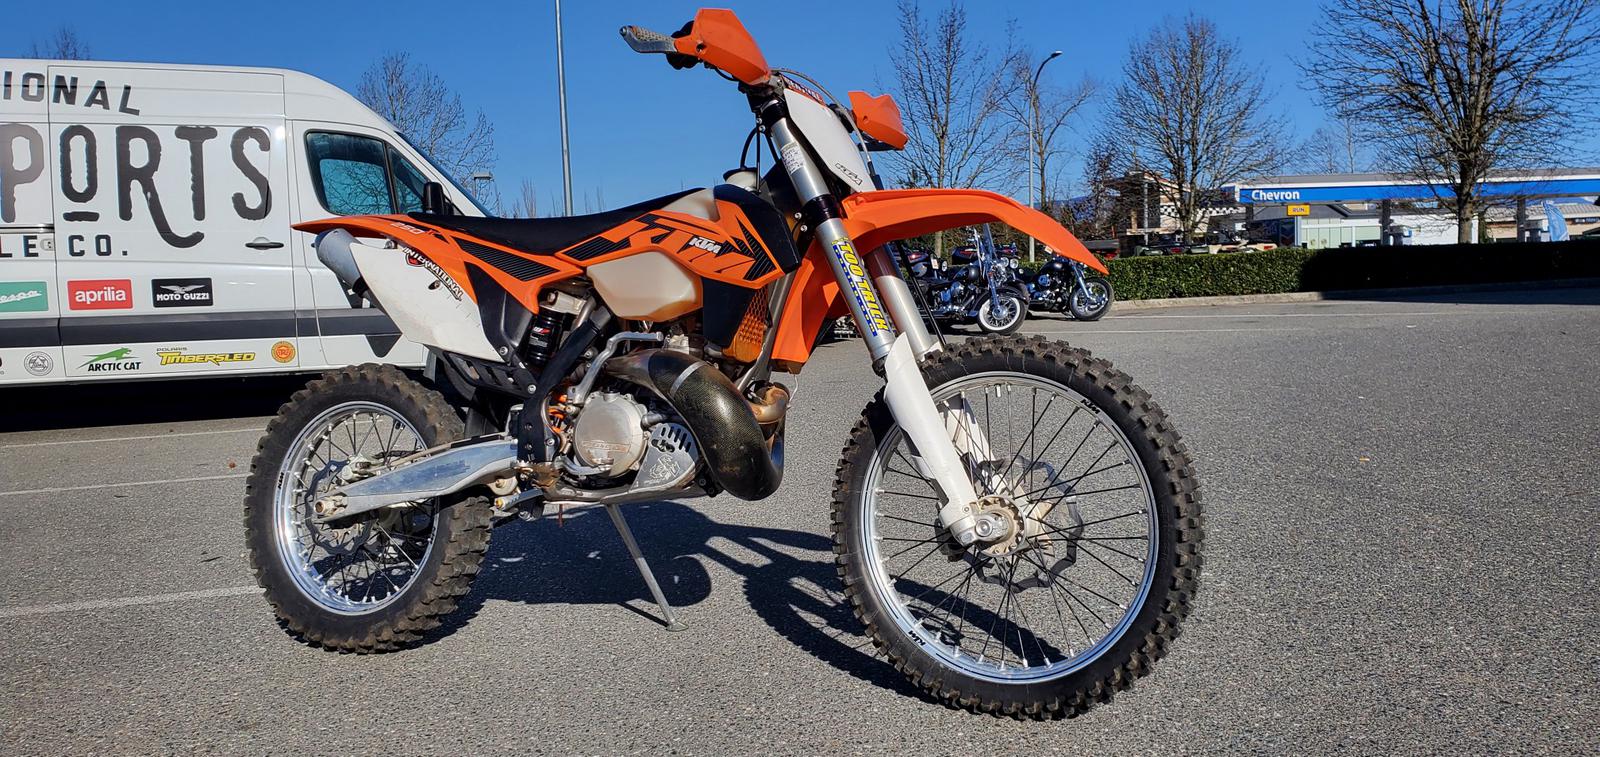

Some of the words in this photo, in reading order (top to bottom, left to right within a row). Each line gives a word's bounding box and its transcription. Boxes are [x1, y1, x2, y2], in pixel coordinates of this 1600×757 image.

[4, 71, 140, 116] IONAL
[0, 123, 273, 248] PORTS
[1251, 190, 1300, 200] Chevron
[68, 234, 128, 257] CO.
[688, 236, 722, 254] KTM
[75, 286, 127, 305] aprilia
[156, 293, 181, 301] MOTO
[183, 292, 210, 300] GUZZI
[840, 242, 865, 278] TOO
[855, 279, 890, 333] TRICK
[88, 362, 122, 372] ARCTIC
[123, 361, 142, 371] CAT
